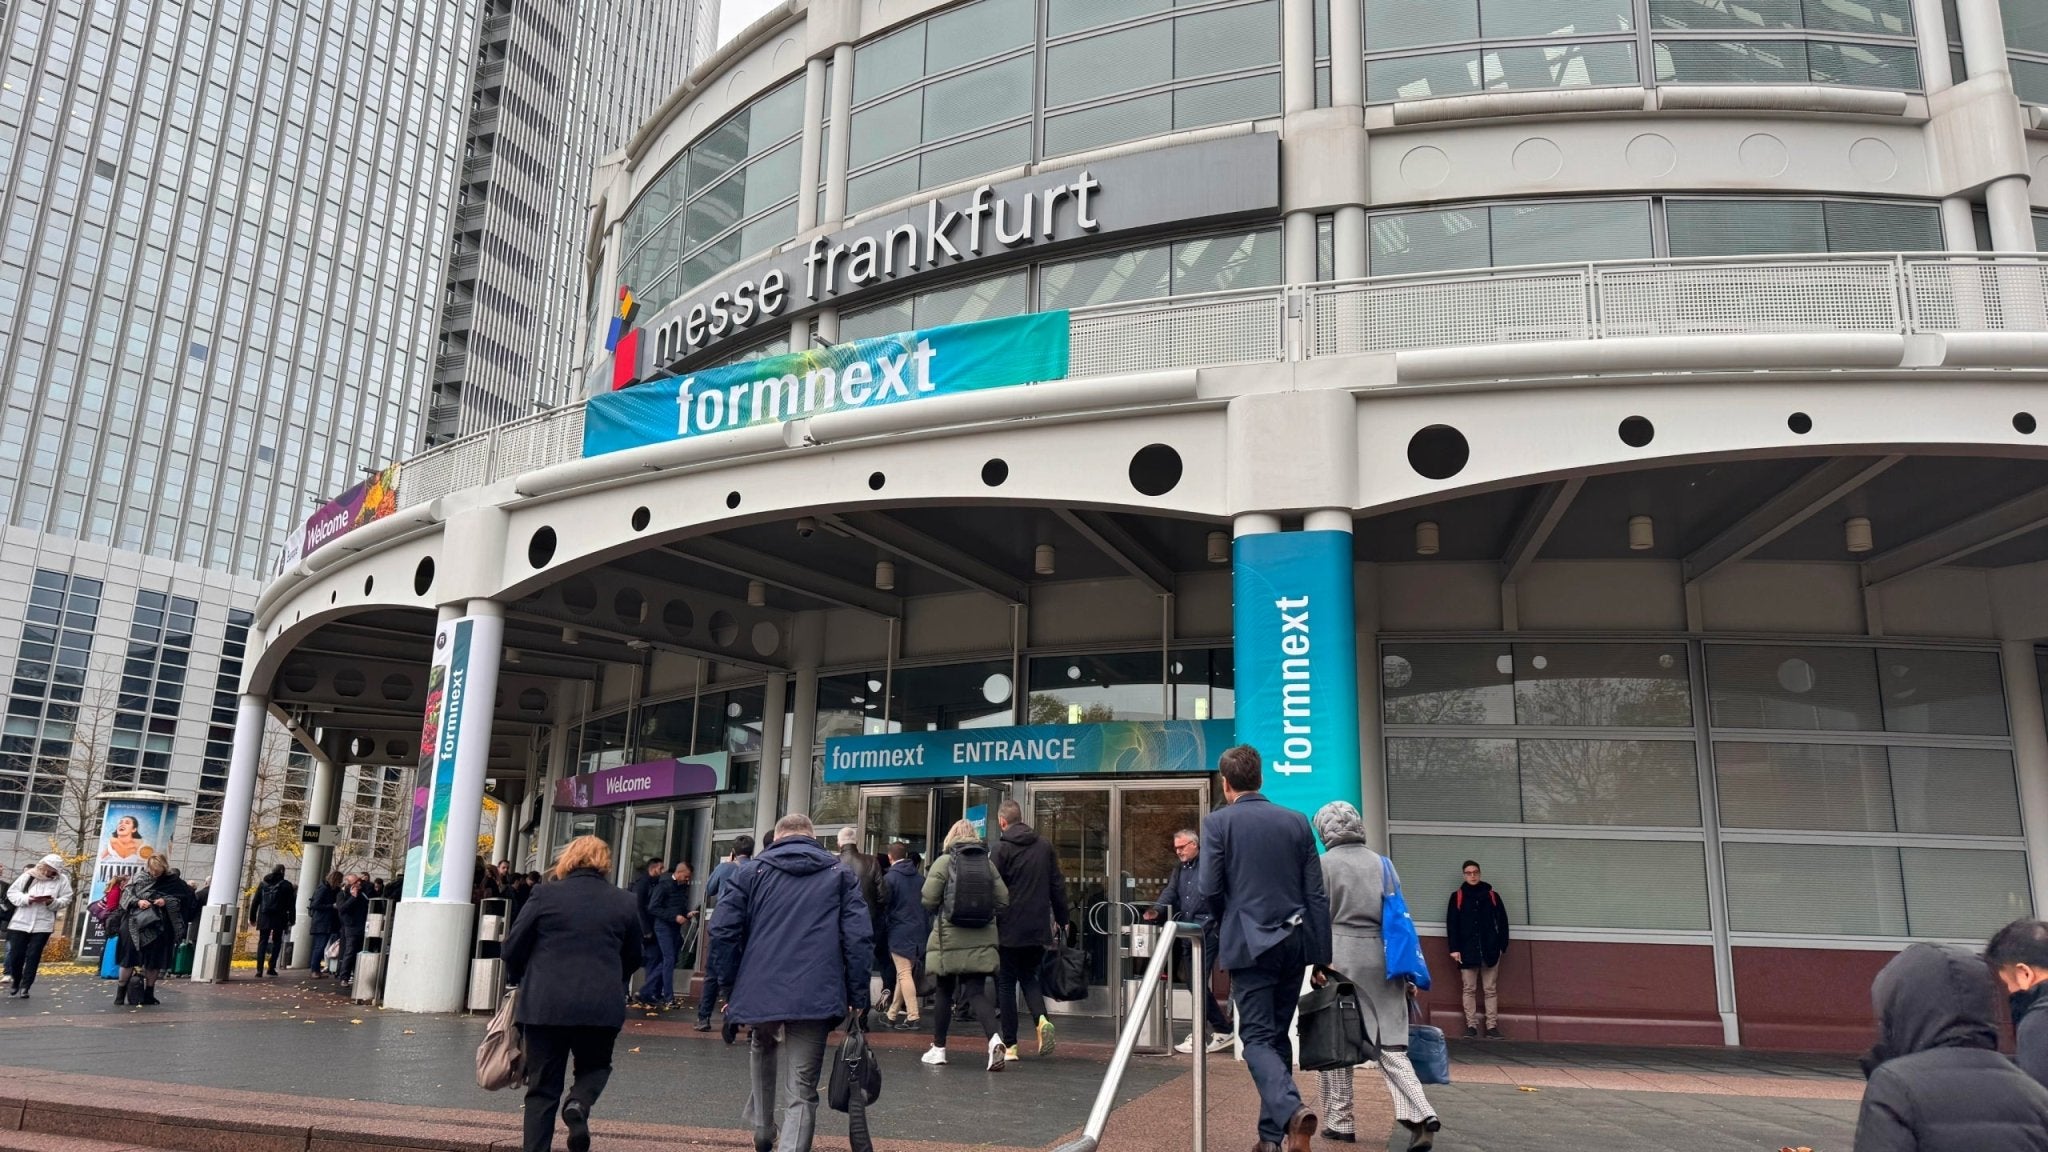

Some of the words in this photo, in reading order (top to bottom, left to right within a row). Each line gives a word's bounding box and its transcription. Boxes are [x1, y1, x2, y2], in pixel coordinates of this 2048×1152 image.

[652, 269, 788, 367] messe
[803, 170, 1101, 301] frankfurt
[676, 338, 937, 436] formnext
[307, 509, 349, 551] Welcome
[440, 668, 464, 760] formnext
[1273, 595, 1313, 777] formnext
[606, 775, 651, 795] Welcome
[832, 743, 925, 770] formnext
[953, 738, 1076, 764] ENTRANCE
[304, 830, 319, 838] TAXI
